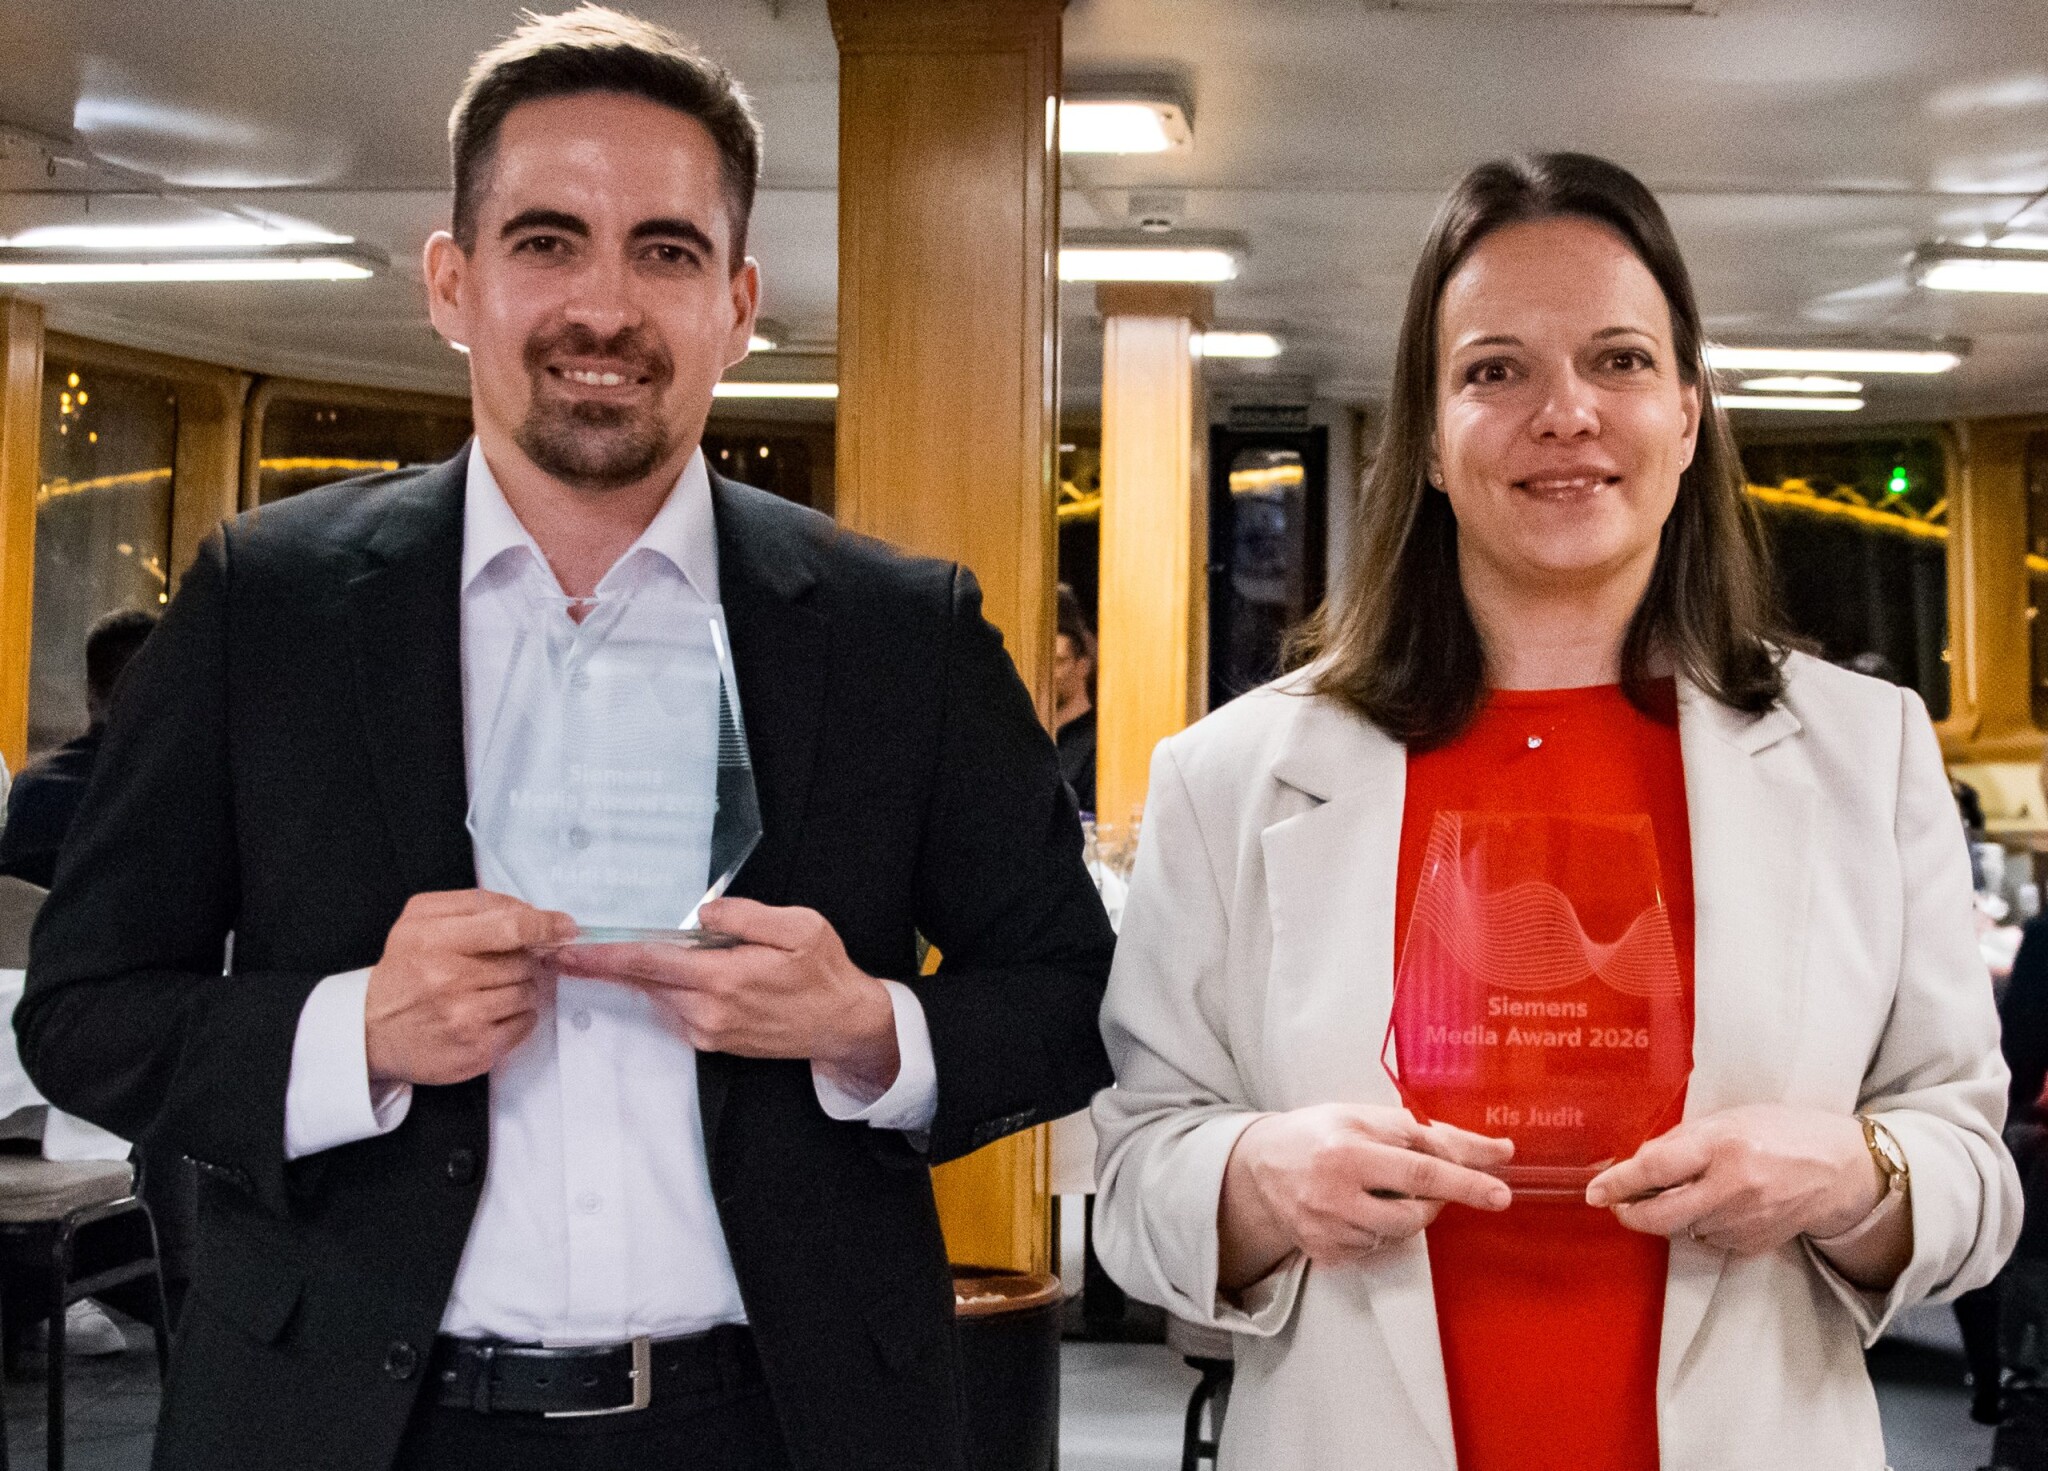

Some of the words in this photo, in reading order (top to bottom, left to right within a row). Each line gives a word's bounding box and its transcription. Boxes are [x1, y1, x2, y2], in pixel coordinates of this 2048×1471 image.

[1488, 996, 1588, 1018] Siemens
[1424, 1024, 1498, 1046] Media
[1505, 1026, 1581, 1047] Award
[1588, 1028, 1649, 1048] 2026
[1485, 1106, 1520, 1127] Kis
[1526, 1106, 1585, 1127] Judit
